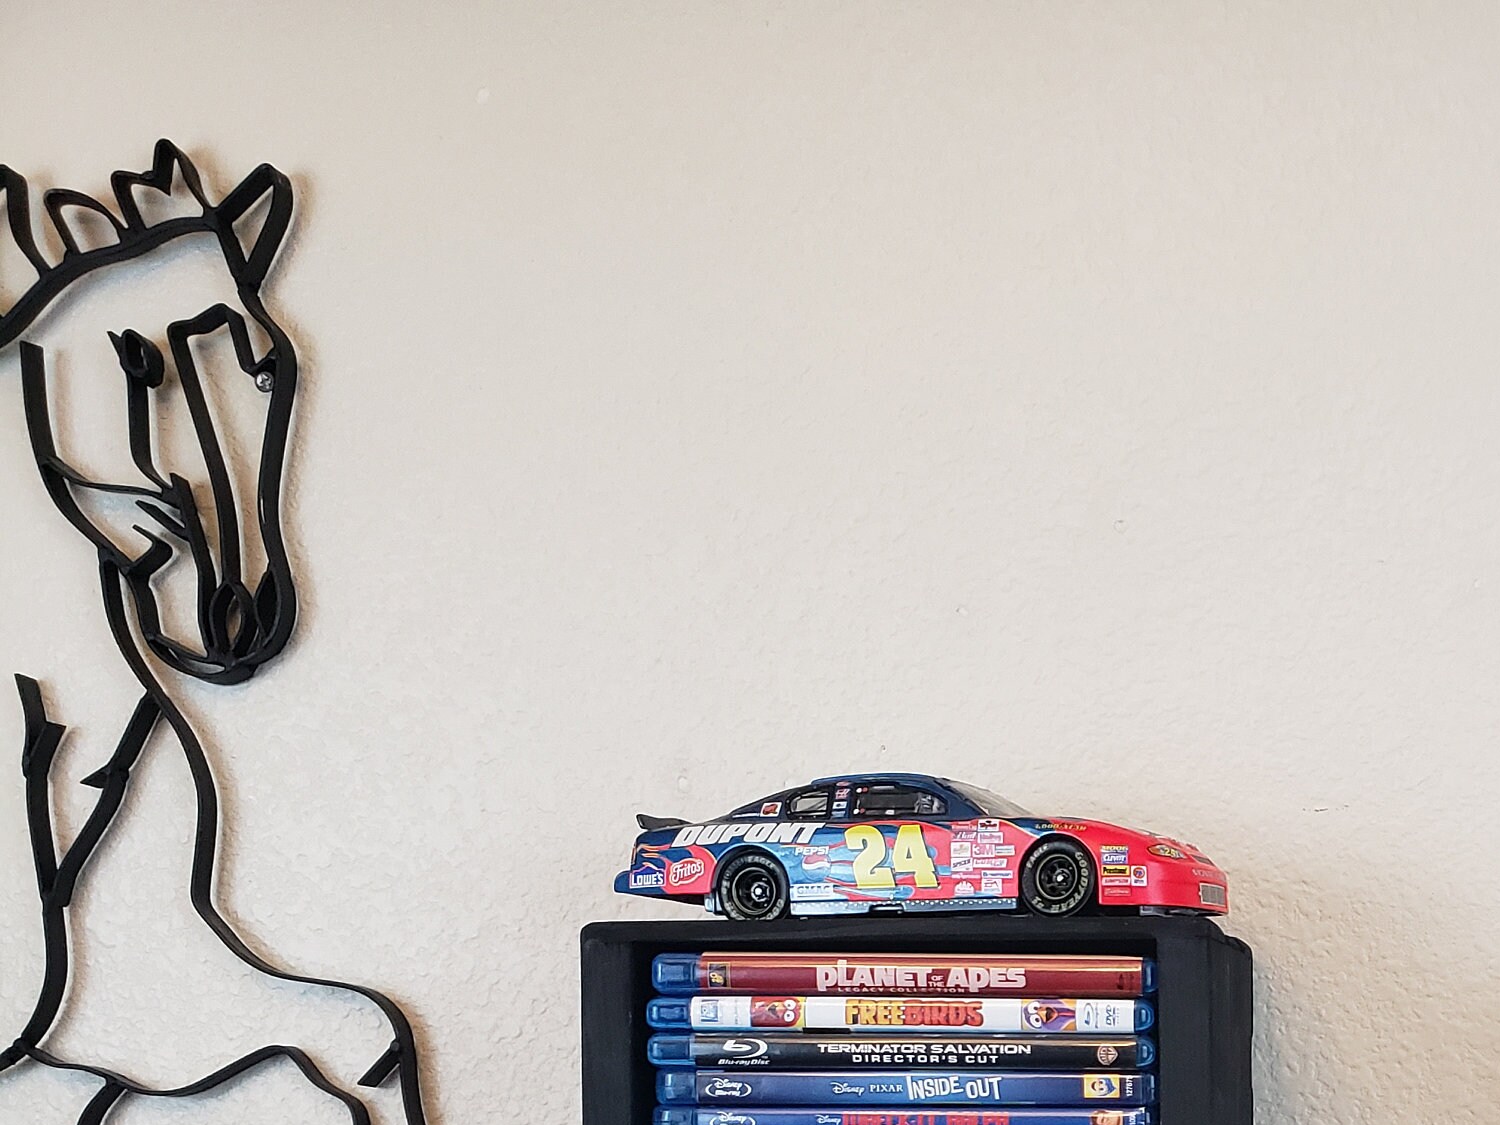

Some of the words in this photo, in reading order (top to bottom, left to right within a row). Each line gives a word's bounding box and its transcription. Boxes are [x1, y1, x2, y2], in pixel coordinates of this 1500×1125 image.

[671, 822, 826, 849] DUPONT
[795, 846, 829, 856] PEPSI
[844, 824, 940, 889] 24
[671, 860, 703, 882] Fritos
[631, 872, 665, 886] LOWE'S
[816, 960, 932, 992] PLANET
[946, 968, 1027, 992] APES
[817, 1043, 926, 1055] TERMINATOR
[930, 1044, 1032, 1055] SALVATION
[852, 1054, 958, 1064] DIRECTOR'S
[967, 1055, 998, 1064] CUT
[712, 1078, 743, 1089] Disney
[830, 1082, 865, 1096] Disney
[869, 1084, 904, 1093] PIXAR
[907, 1075, 964, 1100] INSIDE
[966, 1076, 1003, 1100] OUT
[815, 1114, 842, 1125] Disney
